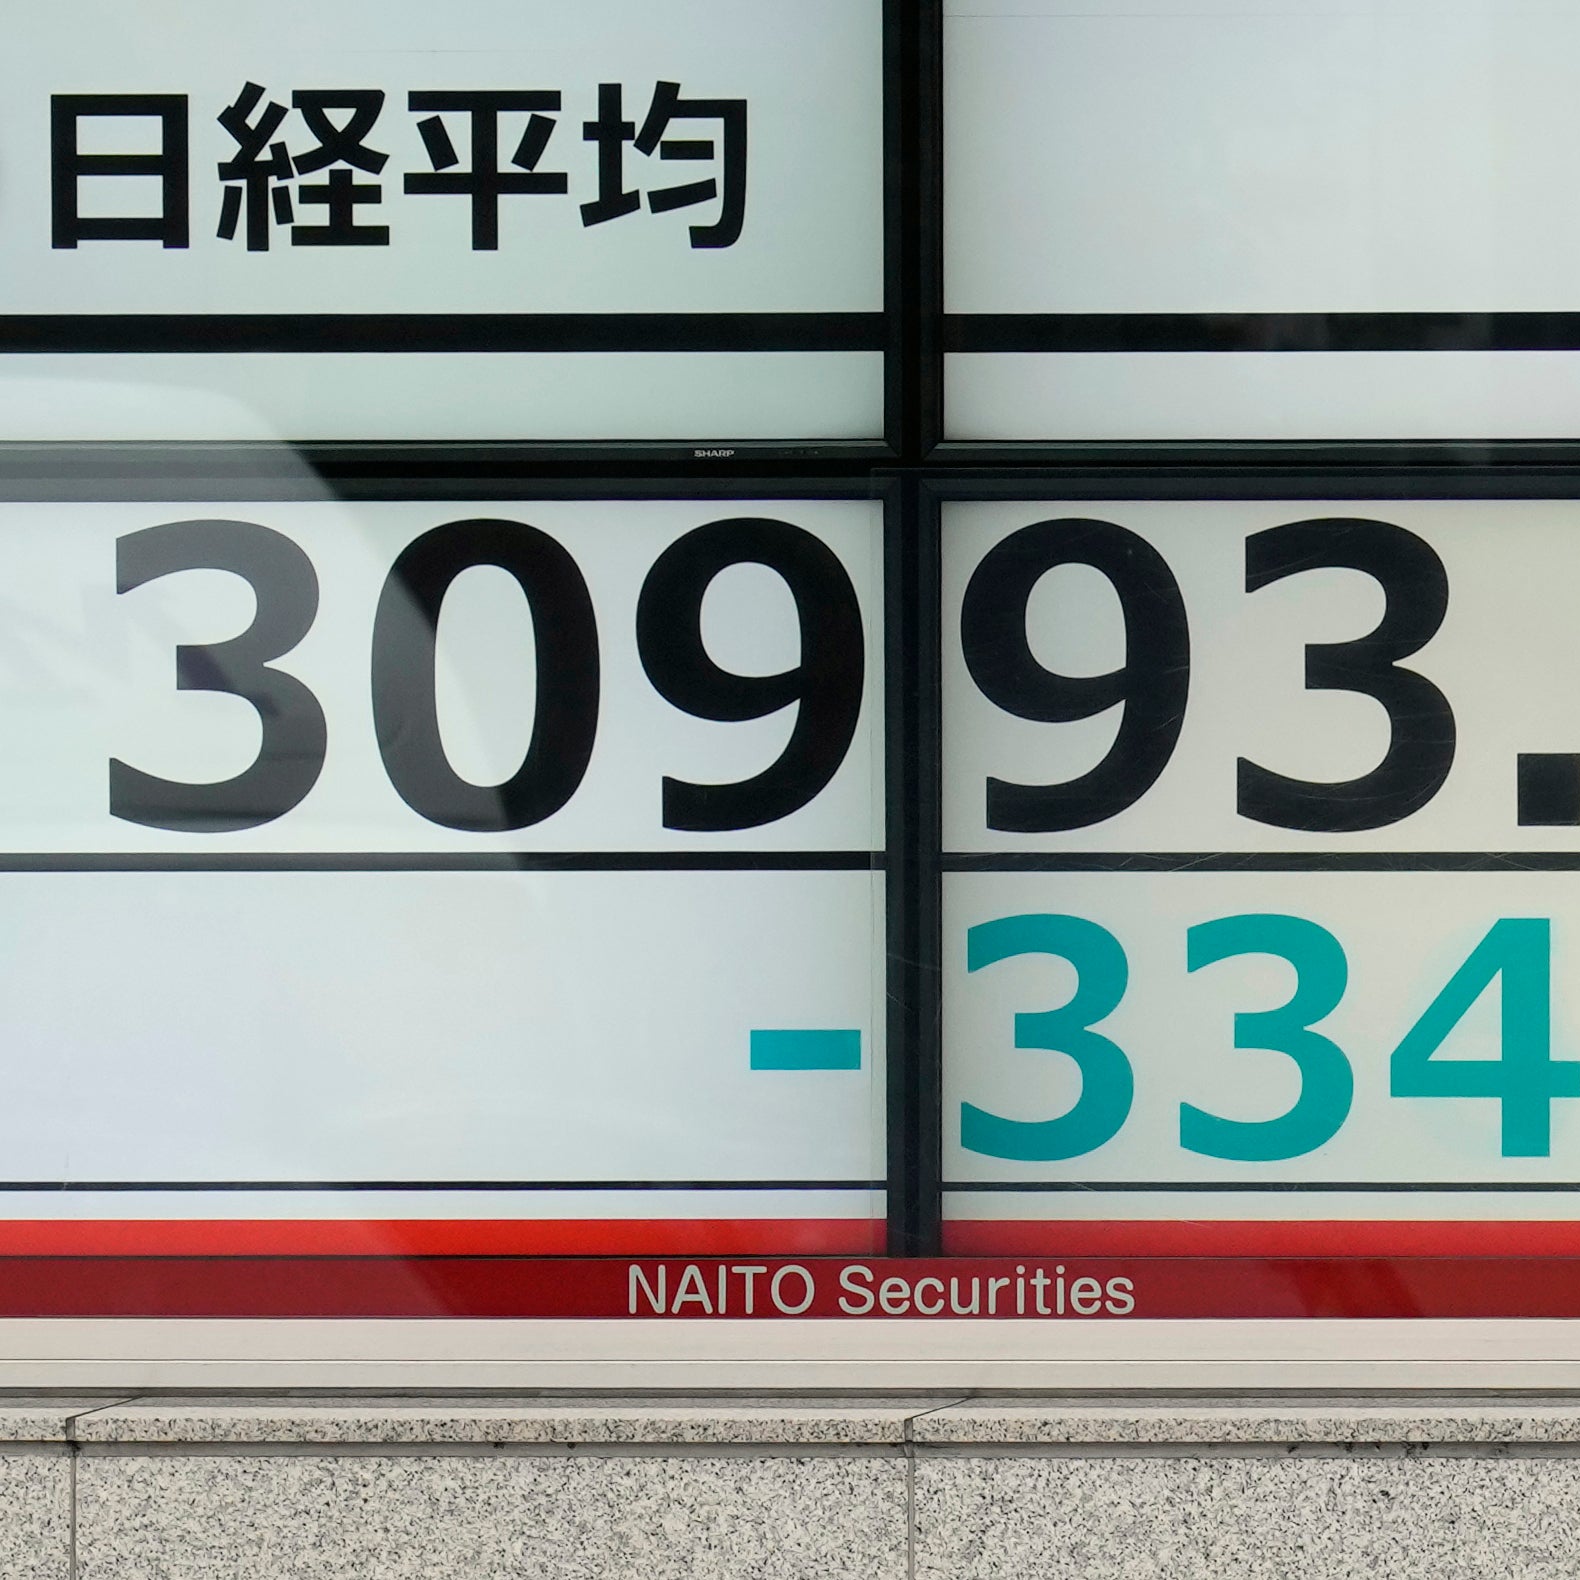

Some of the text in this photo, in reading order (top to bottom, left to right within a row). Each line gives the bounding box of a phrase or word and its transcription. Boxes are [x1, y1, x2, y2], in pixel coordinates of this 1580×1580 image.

[51, 81, 747, 251] 日経平均
[694, 449, 735, 458] SHARP
[628, 1264, 1136, 1316] NAITO Securities
